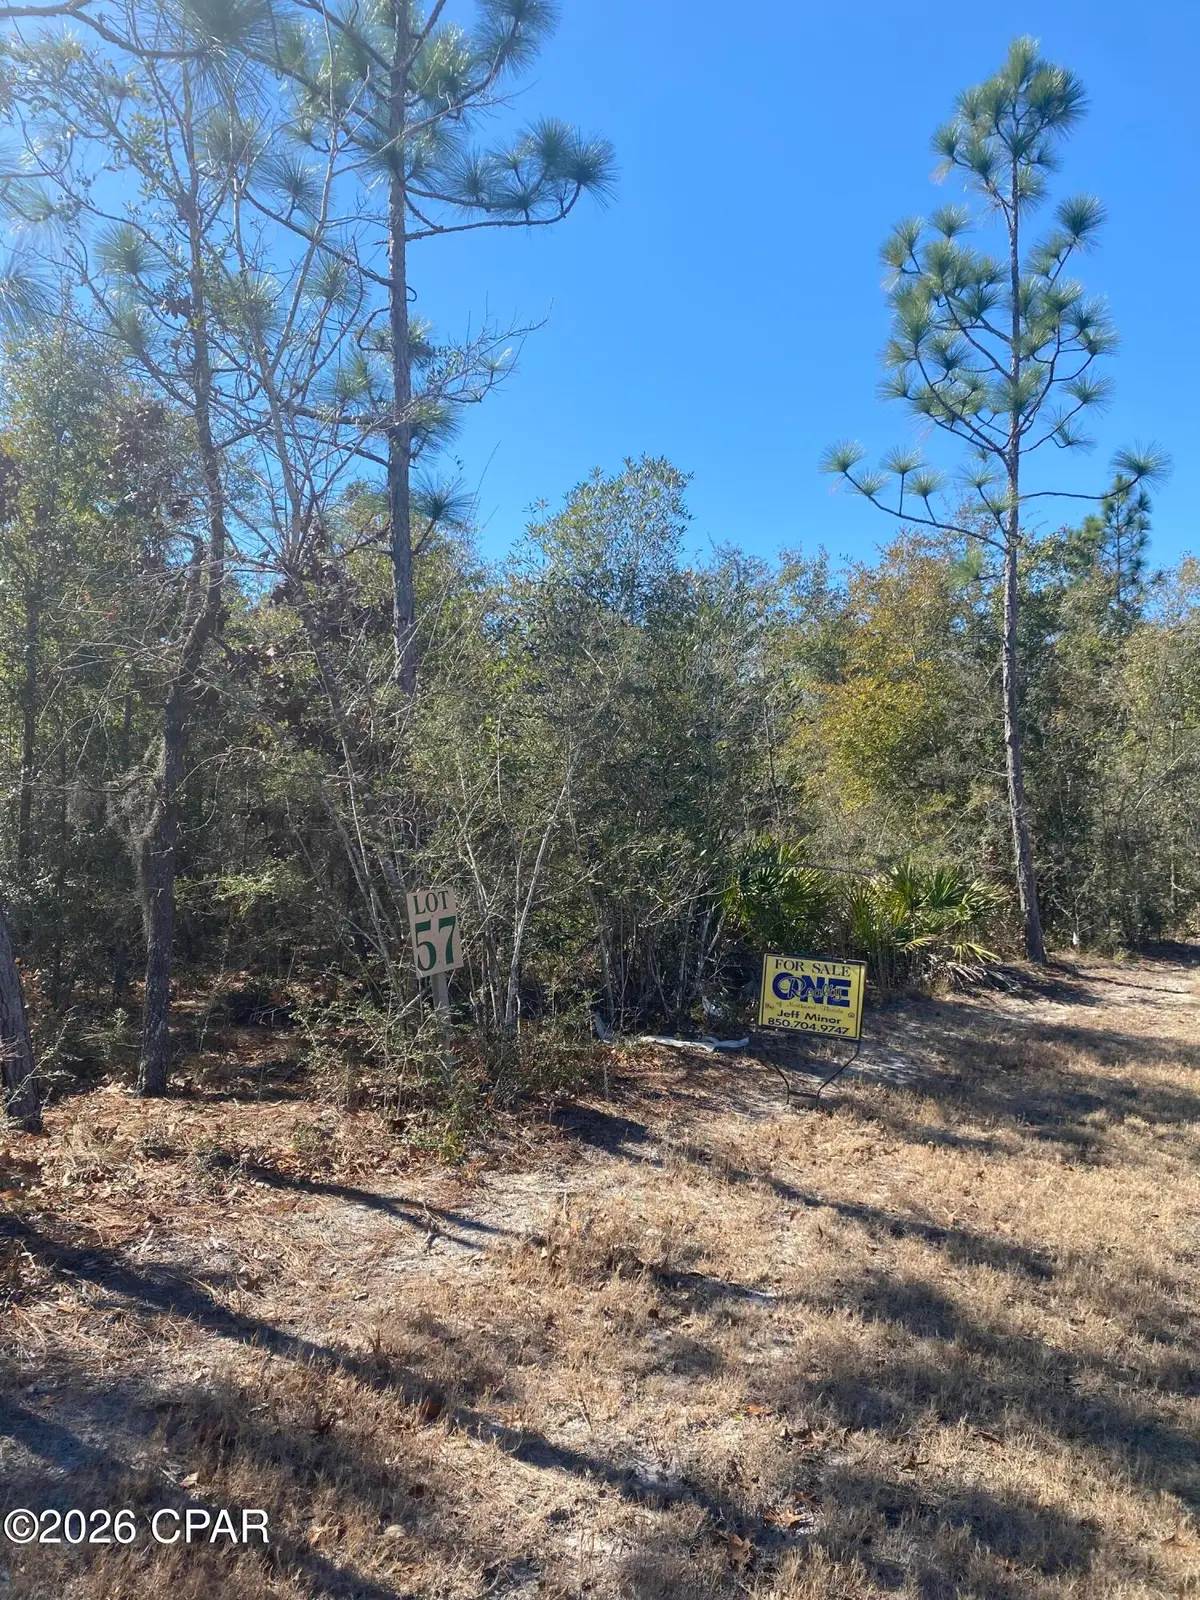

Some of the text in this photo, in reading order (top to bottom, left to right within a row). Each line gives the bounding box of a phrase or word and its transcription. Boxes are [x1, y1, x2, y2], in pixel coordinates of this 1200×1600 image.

[413, 890, 449, 915] LOT
[414, 915, 456, 972] 57
[775, 959, 851, 977] FOR SALE
[772, 972, 851, 1008] ONE
[778, 976, 842, 1001] Realty
[768, 1017, 850, 1035] 850.704.9747
[777, 1009, 842, 1024] Jeff Minor
